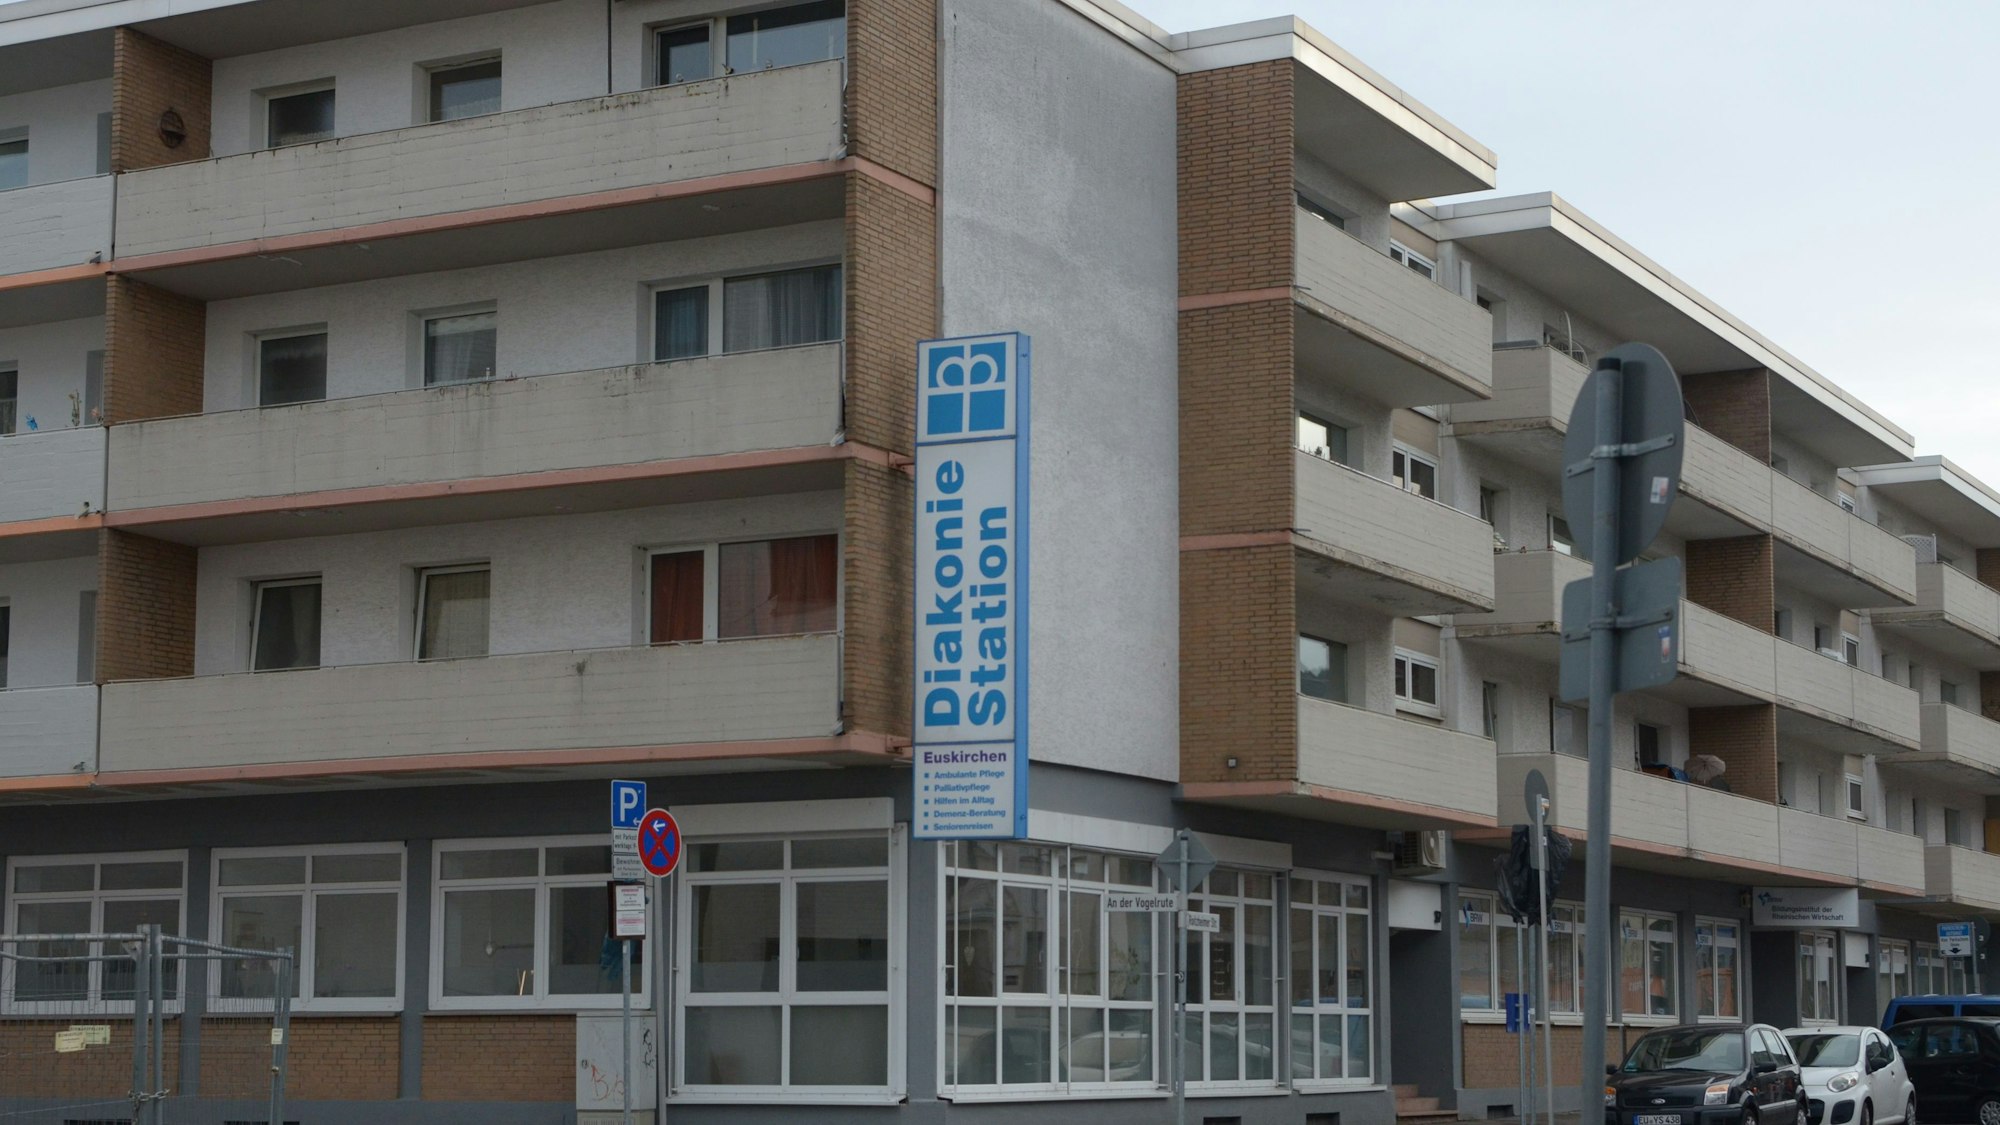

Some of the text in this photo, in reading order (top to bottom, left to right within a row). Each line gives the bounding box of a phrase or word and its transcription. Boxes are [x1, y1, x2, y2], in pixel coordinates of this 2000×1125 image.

[924, 460, 964, 727] Diakonie
[967, 506, 1007, 726] Station
[923, 750, 1007, 764] Euskirchen
[934, 769, 1005, 779] Ambulante Pflege
[934, 783, 990, 793] Palliativpflege
[619, 787, 639, 822] P
[934, 796, 995, 805] Hilfen im Alltag
[934, 809, 1006, 818] Demenz-Beratung
[933, 822, 993, 831] Seniorenreisen
[1107, 898, 1174, 910] An der Vogelrute
[1771, 905, 1820, 913] Bildungsinstitut
[1811, 913, 1844, 921] Wirtschaft
[1638, 1116, 1680, 1124] EU YS 438
